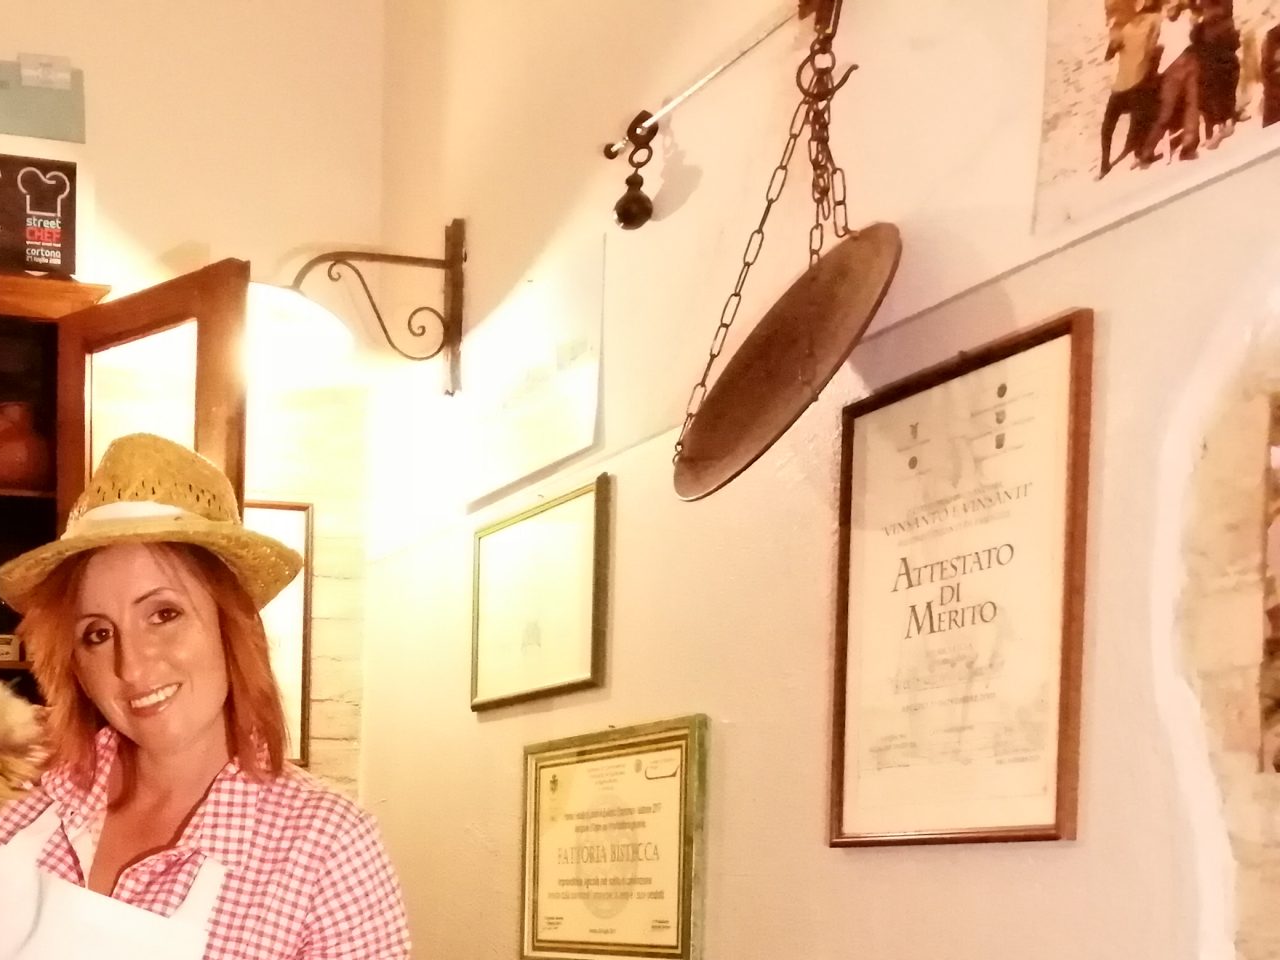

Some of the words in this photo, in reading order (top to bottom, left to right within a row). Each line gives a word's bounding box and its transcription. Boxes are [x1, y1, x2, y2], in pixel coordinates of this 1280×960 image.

[26, 215, 62, 230] street
[26, 227, 61, 243] CHEF
[26, 247, 61, 259] cortona
[890, 543, 1016, 594] ATTESTATO
[939, 582, 961, 607] DI
[904, 600, 999, 640] MERITO
[557, 845, 607, 865] FATTORIA
